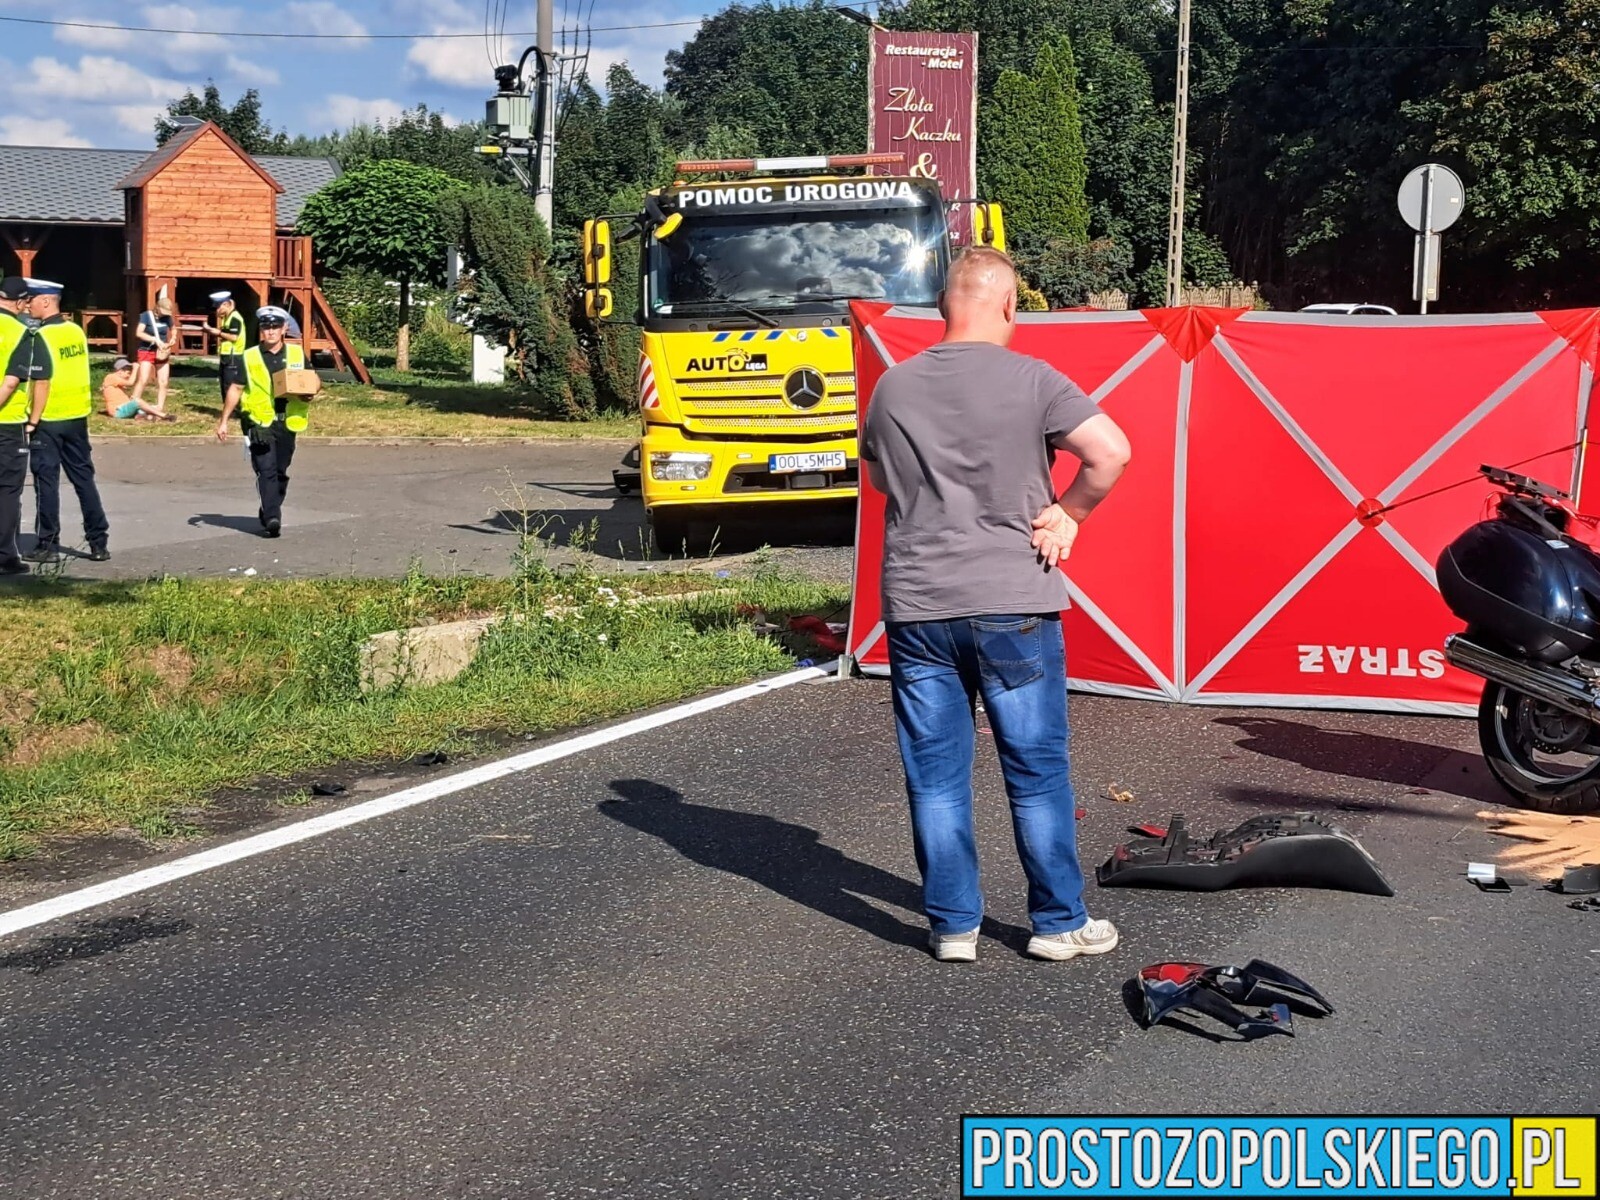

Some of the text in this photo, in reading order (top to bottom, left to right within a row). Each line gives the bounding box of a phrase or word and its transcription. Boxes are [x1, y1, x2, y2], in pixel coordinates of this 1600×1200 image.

[885, 44, 957, 59] Restauracja
[927, 57, 964, 70] Motel
[910, 152, 938, 180] &
[678, 181, 915, 209] POMOC DROGOWA
[686, 355, 745, 373] AUTO
